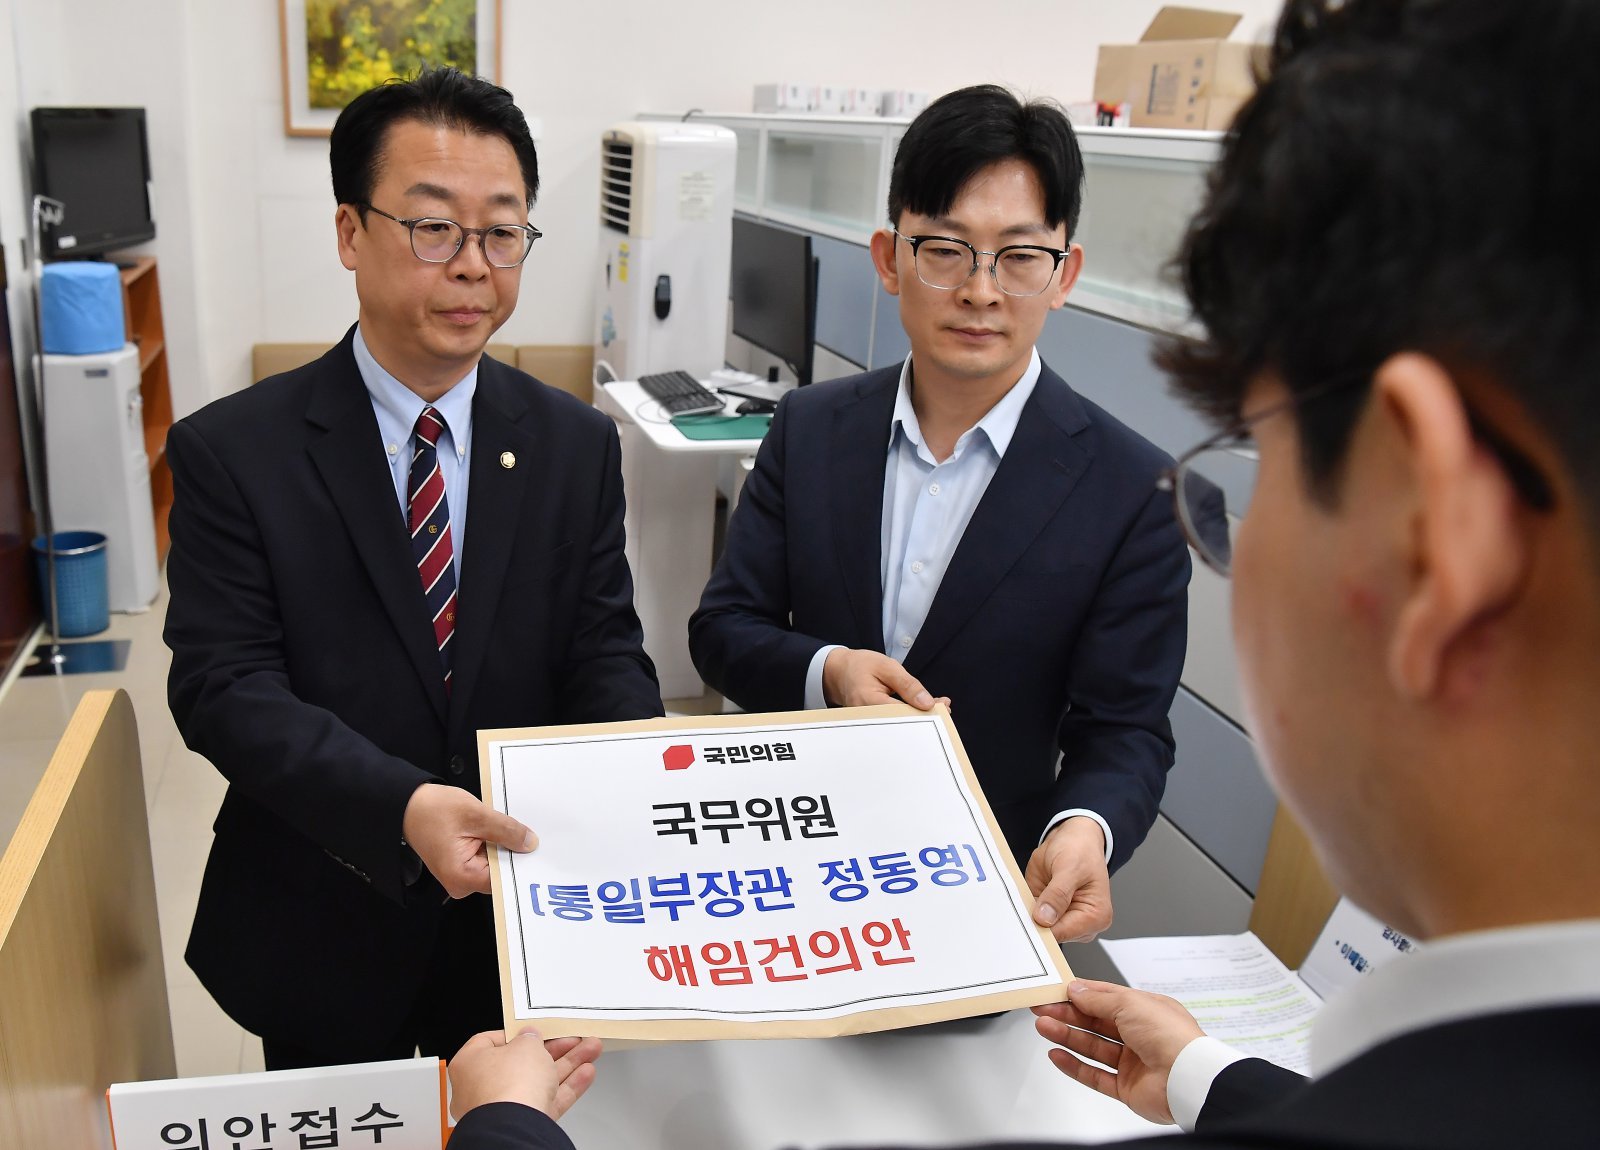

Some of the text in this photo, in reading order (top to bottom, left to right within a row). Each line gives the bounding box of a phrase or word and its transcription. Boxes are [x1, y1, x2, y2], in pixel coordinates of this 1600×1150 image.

[703, 742, 796, 765] 국민의힘
[652, 794, 839, 845] 국무위원
[819, 843, 987, 903] 정동영]
[643, 917, 916, 987] 해임건의안
